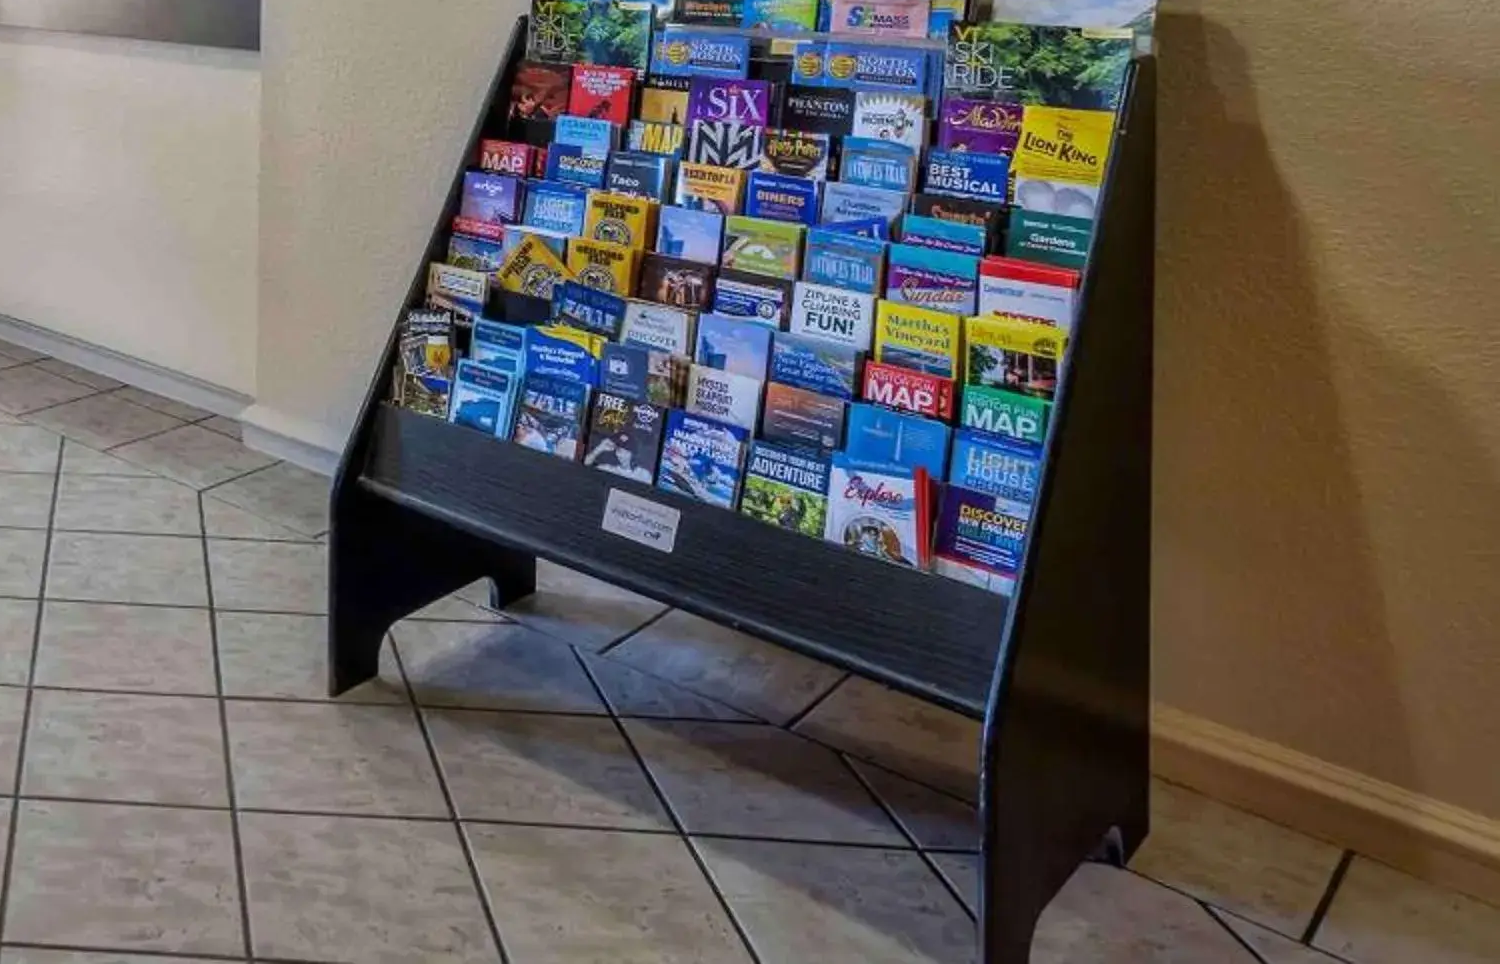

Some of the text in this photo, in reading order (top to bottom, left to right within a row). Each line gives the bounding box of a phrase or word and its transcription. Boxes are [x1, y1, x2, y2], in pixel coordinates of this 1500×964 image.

[857, 54, 908, 67] NORTH
[955, 40, 995, 65] SKI
[856, 64, 917, 78] BOSTON
[953, 63, 1015, 90] RIDE
[708, 86, 764, 121] SIX
[787, 97, 850, 114] PHANTOM
[641, 122, 684, 155] MAP
[1023, 131, 1098, 166] LION KING
[481, 151, 524, 173] MAP
[929, 163, 973, 179] BEST
[610, 173, 641, 188] Taco
[927, 174, 1002, 196] MUSICAL
[756, 190, 805, 207] DINERS
[1029, 233, 1076, 249] Gardens
[803, 287, 861, 308] ZIPLINE &
[801, 299, 862, 320] CLIMBING
[805, 311, 856, 336] FUN!
[887, 313, 950, 335] Martha's
[885, 325, 950, 349] Vineyard
[866, 380, 934, 412] MAP
[967, 404, 1038, 438] MAP
[807, 458, 825, 471] NEXT
[967, 446, 1035, 476] LIGHT
[751, 457, 824, 490] ADVENTURE
[966, 464, 1035, 489] HOUSE
[844, 476, 904, 506] Explore
